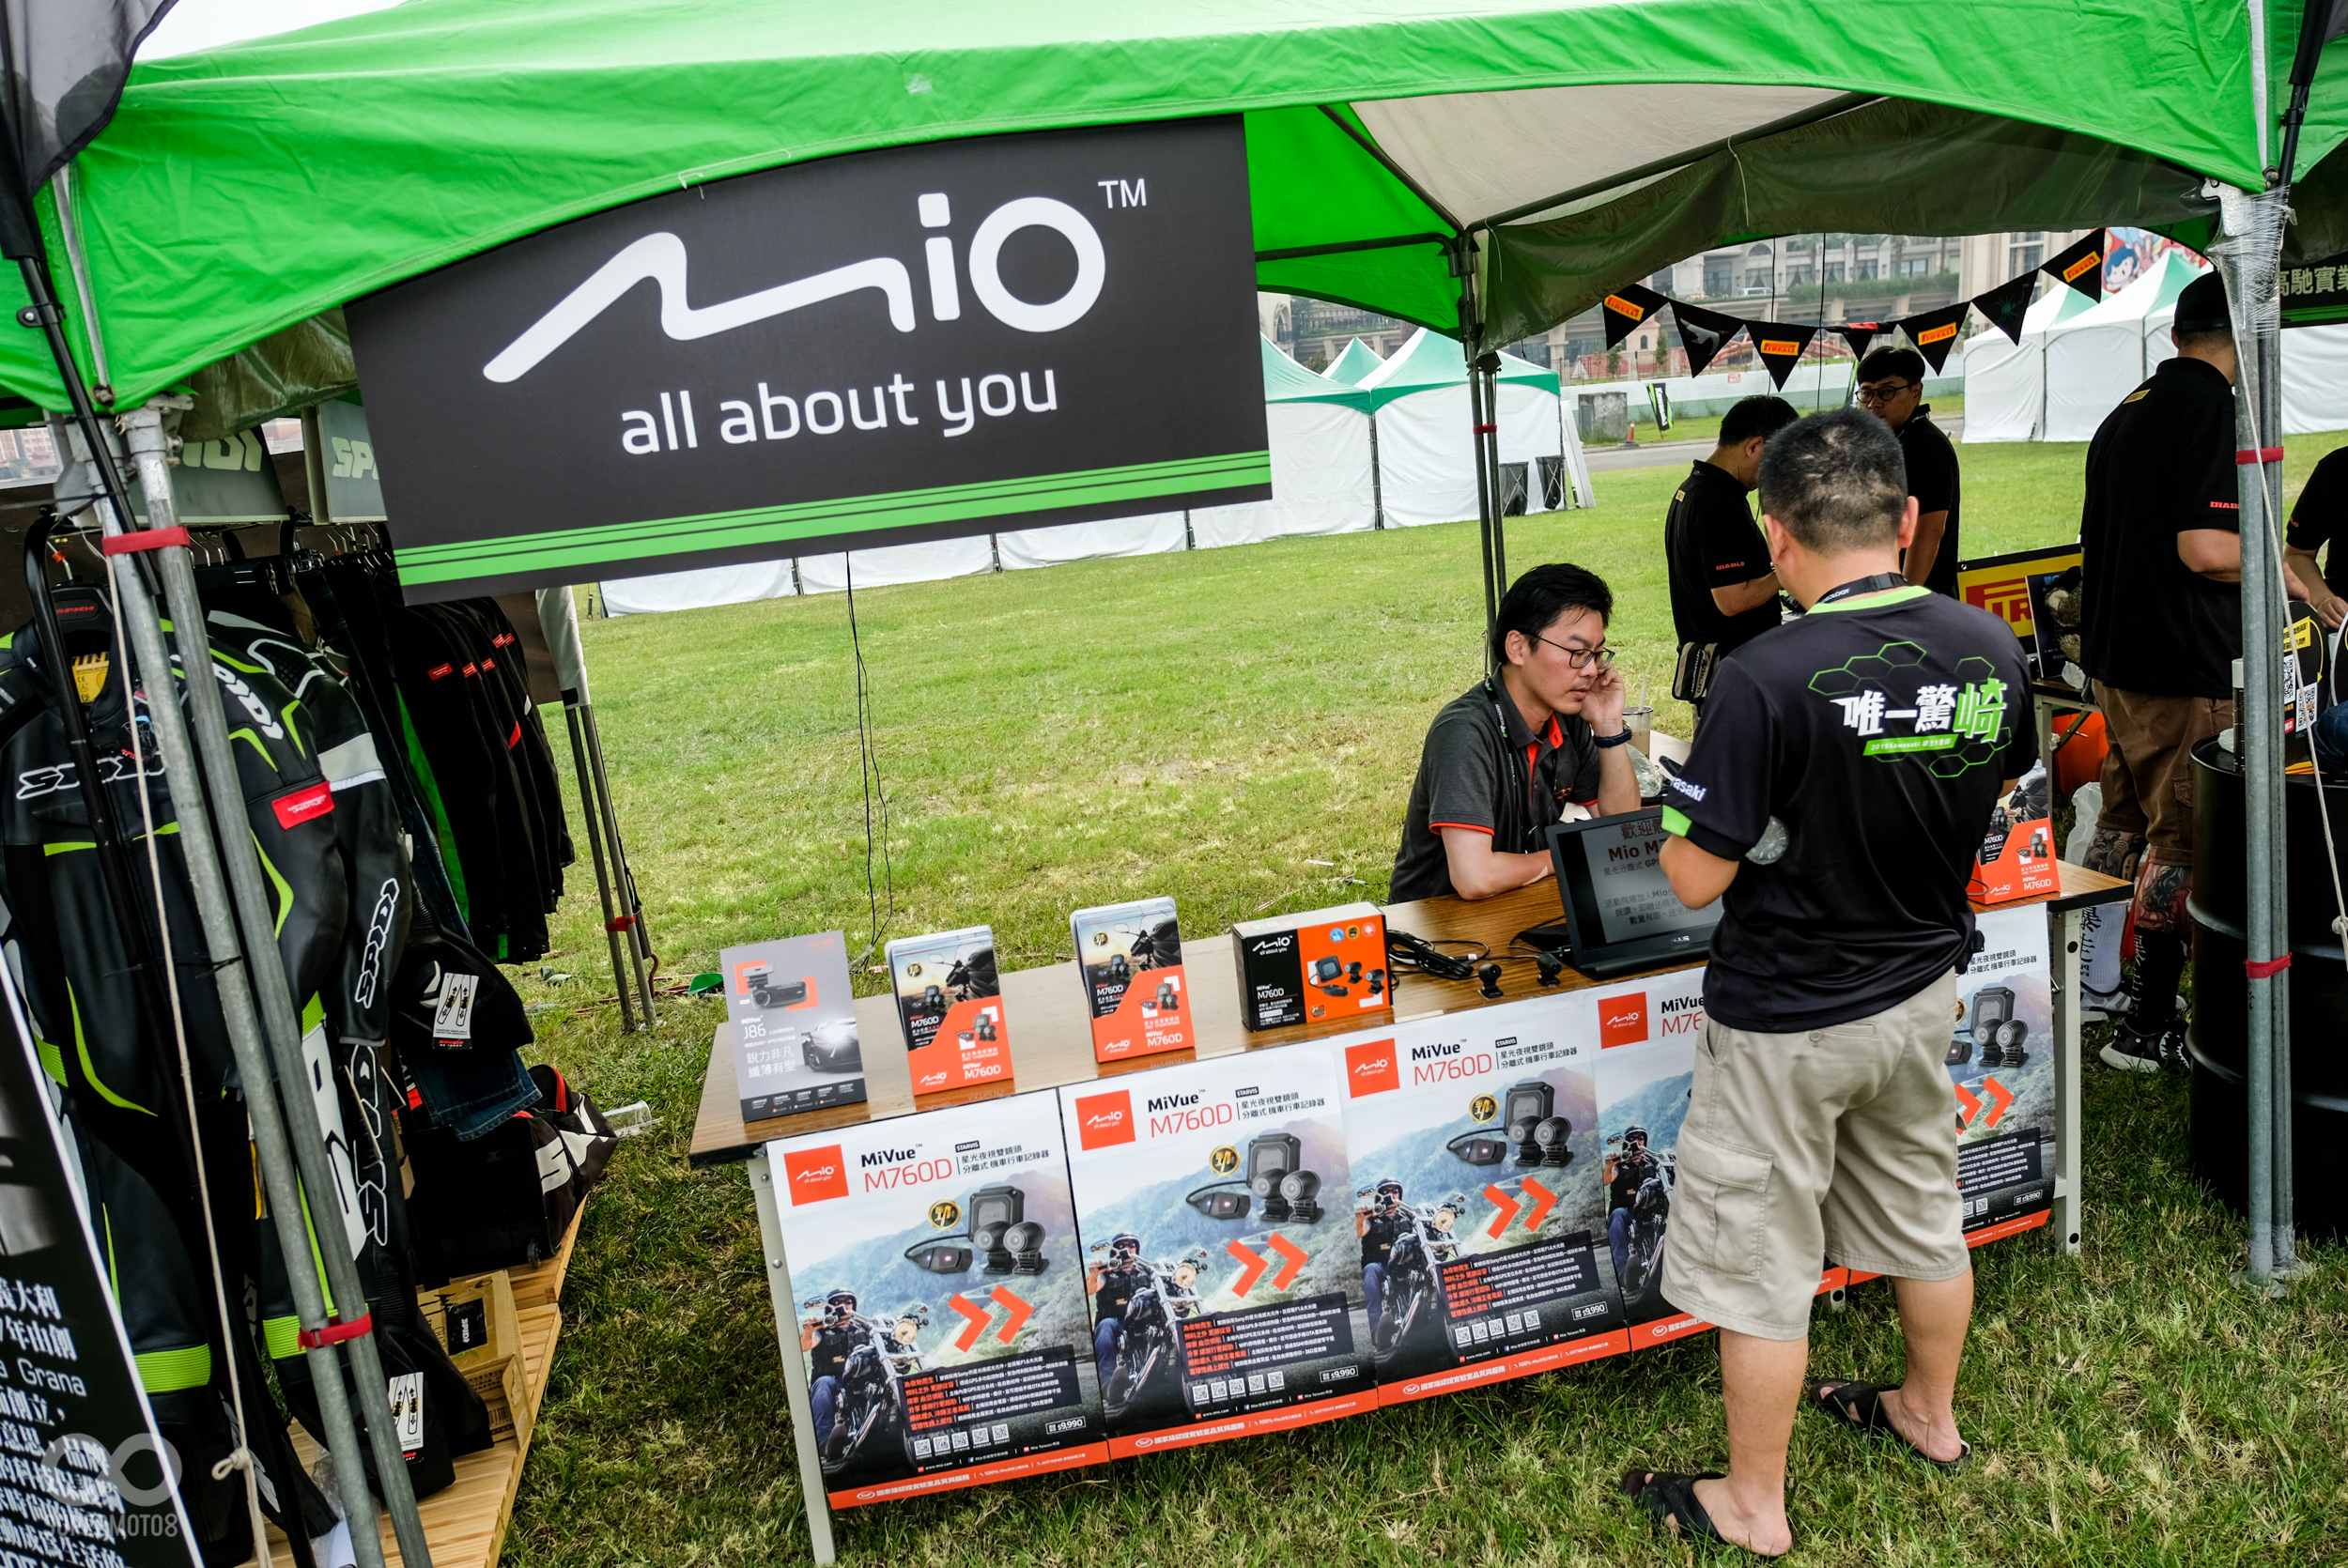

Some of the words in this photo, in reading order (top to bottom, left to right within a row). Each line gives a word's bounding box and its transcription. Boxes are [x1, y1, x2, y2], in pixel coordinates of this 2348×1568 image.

[621, 390, 699, 455] all
[720, 374, 919, 444] about
[937, 369, 1058, 438] you
[1716, 561, 1745, 571] DIABLO
[1829, 677, 2009, 744] 唯一驚崎
[1985, 835, 2002, 844] M760D
[1607, 844, 1640, 862] Mio
[2024, 878, 2051, 891] M760D
[355, 878, 400, 1009] SPIDI
[1970, 965, 1989, 975] 分離式
[1990, 956, 2037, 972] 機車行車記錄器
[1097, 984, 1123, 996] M760D
[1258, 988, 1284, 1000] M760D
[1661, 996, 1704, 1014] MiVue
[743, 1023, 766, 1039] J86
[911, 1016, 939, 1029] M760D
[1148, 1033, 1182, 1047] M760D
[1412, 1042, 1460, 1061] MiVue
[1501, 1042, 1553, 1059] 星光夜視雙鏡頭
[1501, 1057, 1524, 1068] 分離式
[1525, 1048, 1577, 1065] 機車行車記錄器
[965, 1065, 1001, 1080] M760D
[1414, 1053, 1491, 1085] M760D
[1148, 1094, 1199, 1112] MiVue
[1242, 1093, 1299, 1109] 星光夜視雙鏡頭
[1243, 1108, 1267, 1119] 分離式
[1268, 1099, 1324, 1115] 機車行車記錄器
[1151, 1104, 1232, 1138] M760D
[861, 1147, 916, 1167] MiVue
[962, 1145, 1022, 1163] 星光夜視雙鏡頭
[963, 1161, 989, 1174] 分離式
[990, 1149, 1049, 1168] 機車行車記錄器
[865, 1159, 951, 1192] M760D
[1582, 1303, 1605, 1316] $9,990
[17, 1358, 87, 1396] Grana
[1330, 1367, 1355, 1379] $9,990
[1057, 1418, 1084, 1431] $9,990
